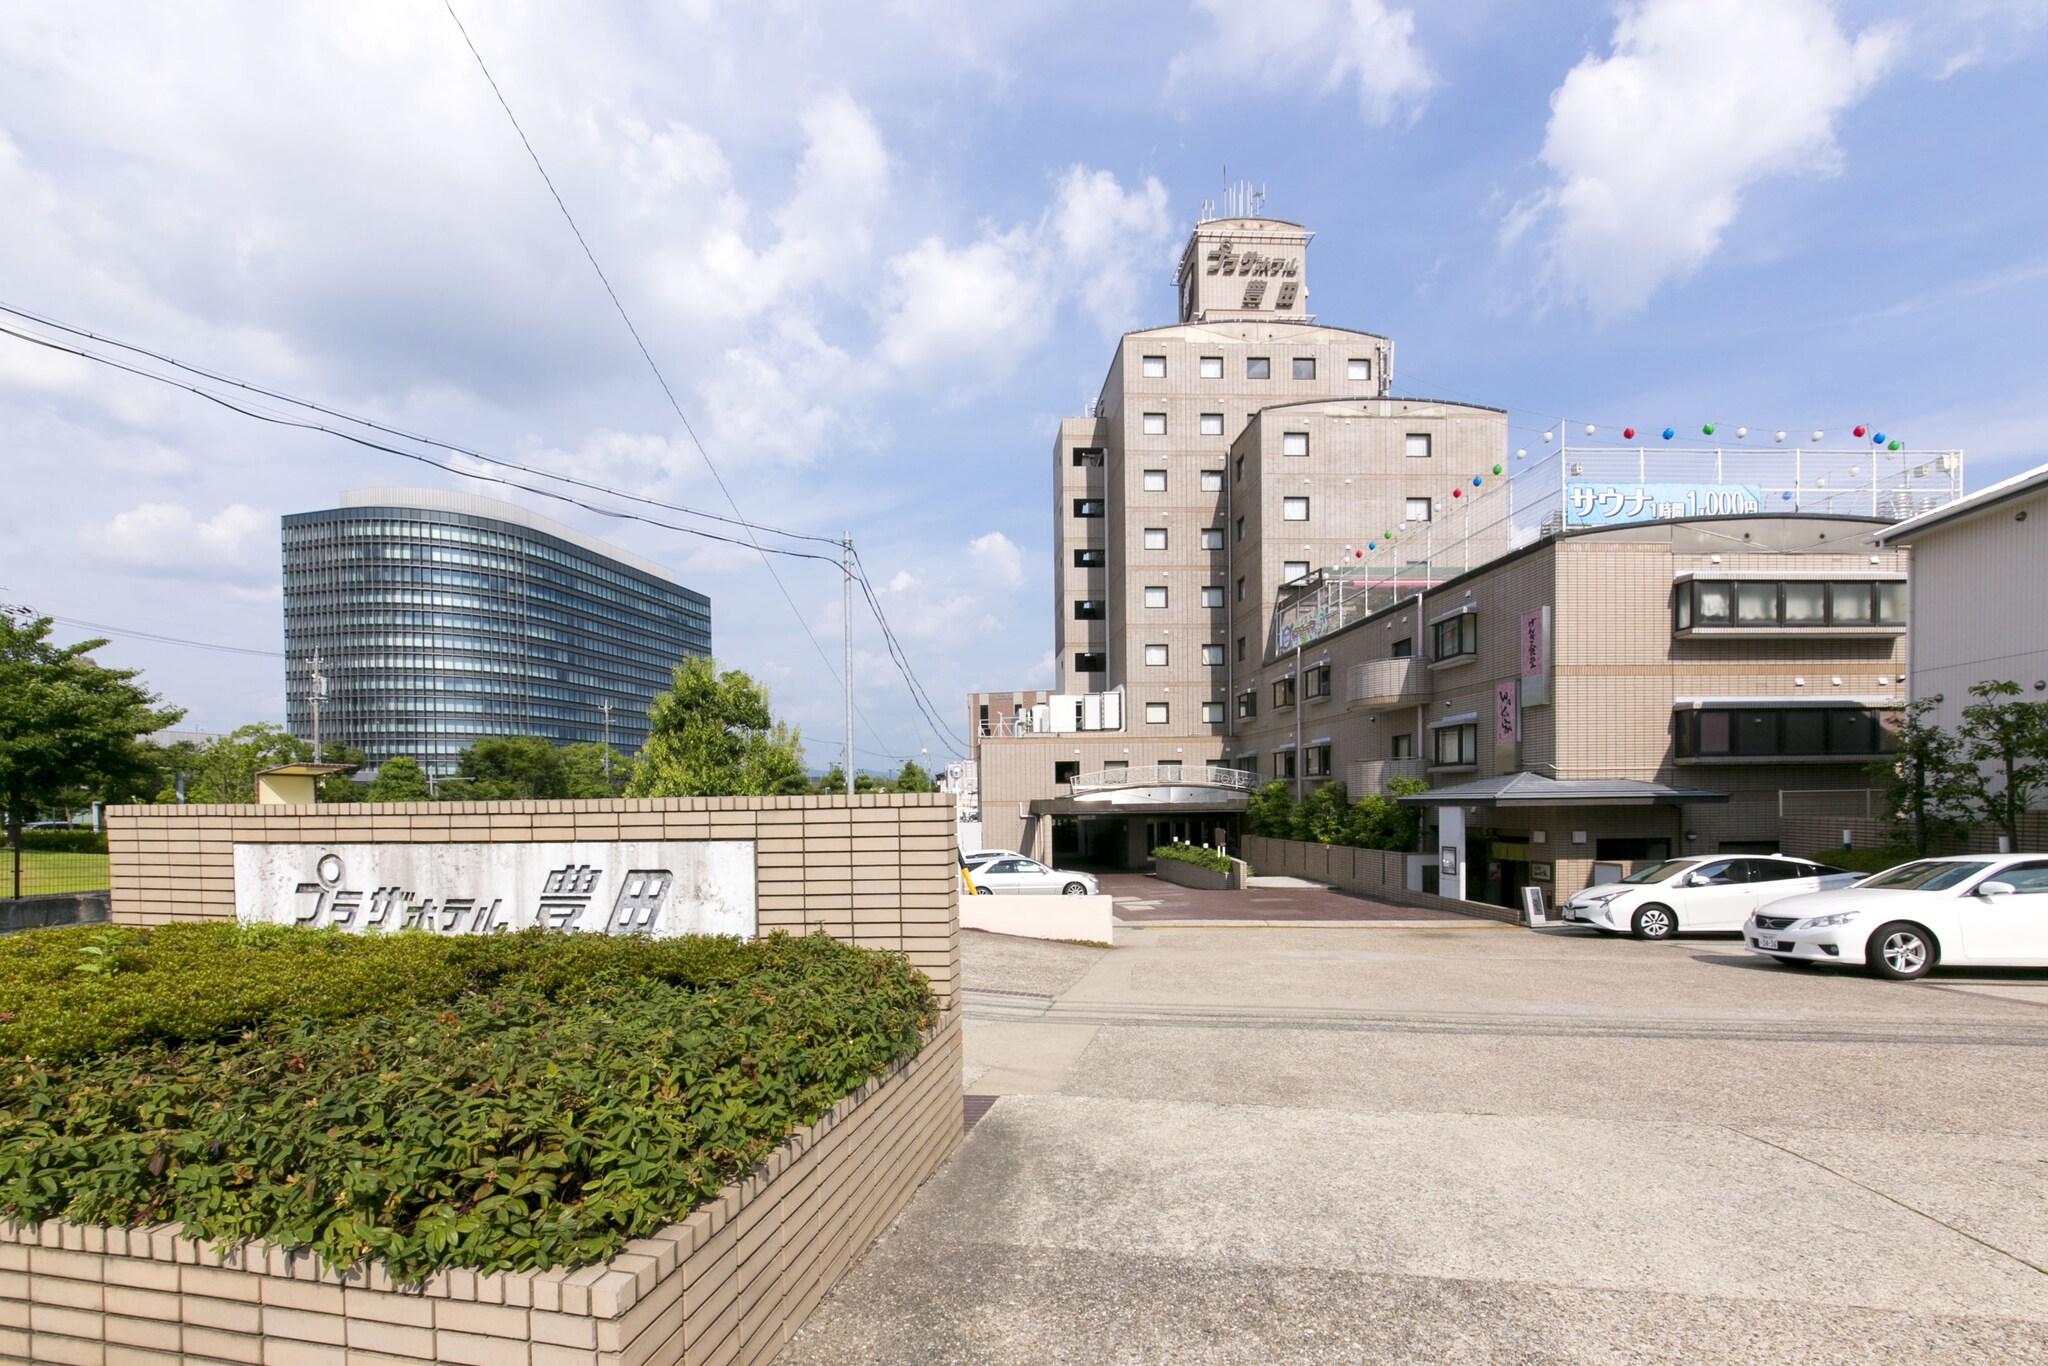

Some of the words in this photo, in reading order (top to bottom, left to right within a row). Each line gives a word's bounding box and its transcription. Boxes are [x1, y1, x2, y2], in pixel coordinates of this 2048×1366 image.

[1207, 239, 1299, 278] プラザホテル
[1241, 279, 1300, 310] 豊田
[1570, 487, 1654, 518] サウナ
[295, 853, 509, 932] プラザホテル
[535, 864, 674, 934] 豊田
